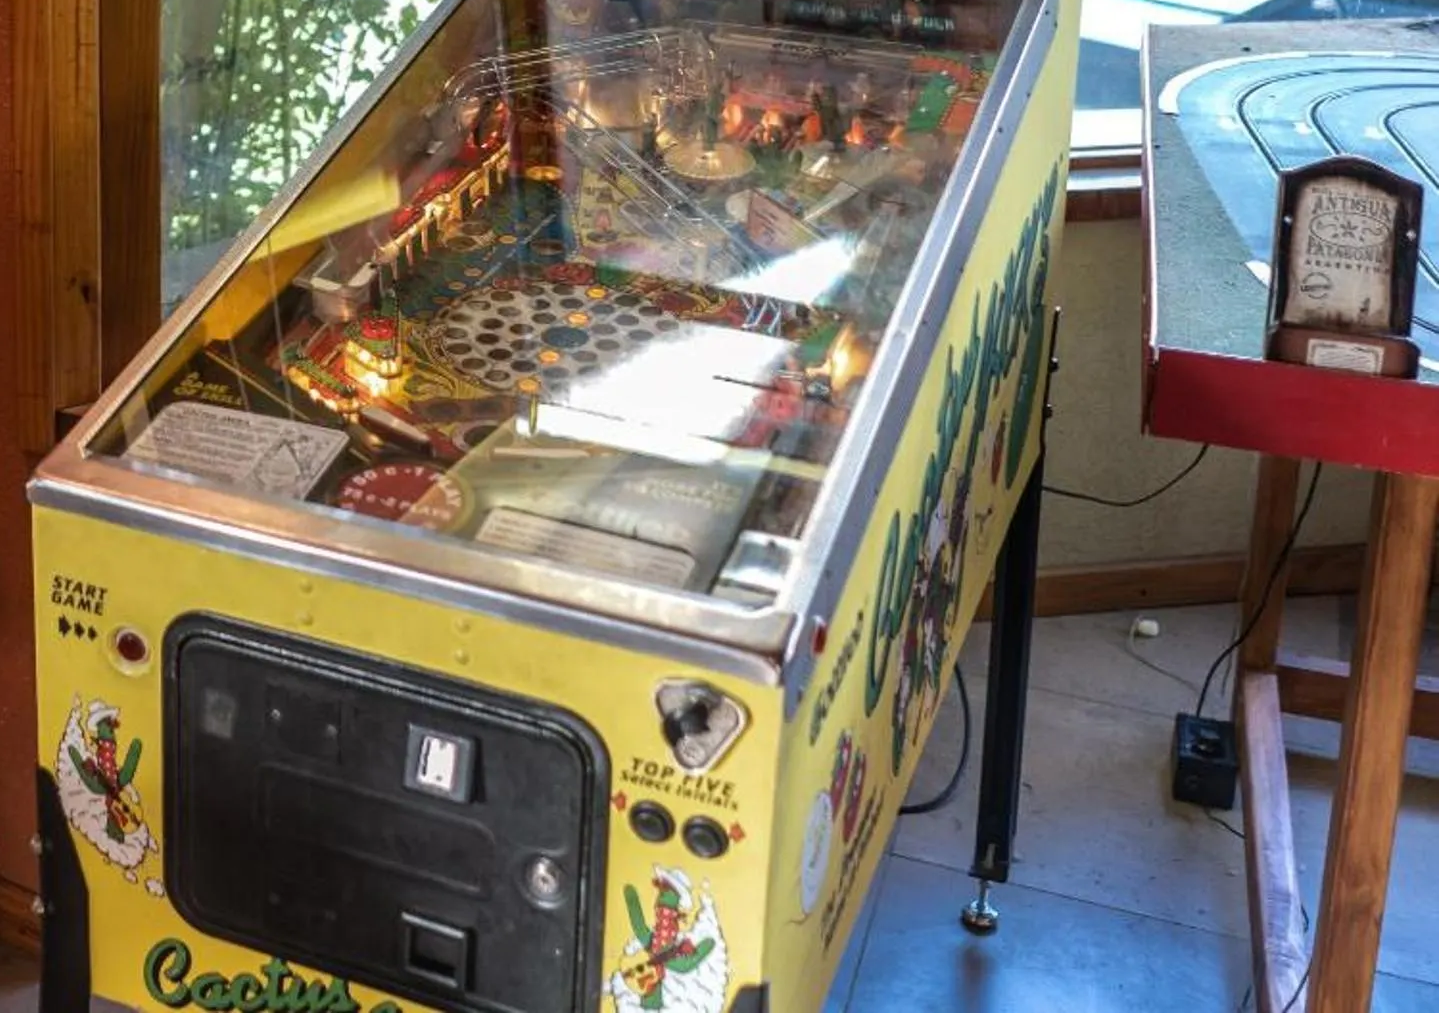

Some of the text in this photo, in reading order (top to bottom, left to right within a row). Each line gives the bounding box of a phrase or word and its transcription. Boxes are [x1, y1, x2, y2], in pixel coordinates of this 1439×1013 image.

[51, 590, 103, 617] GAME
[52, 575, 108, 600] START
[632, 757, 736, 797] TOP FIVE
[144, 937, 361, 1012] Cactus
